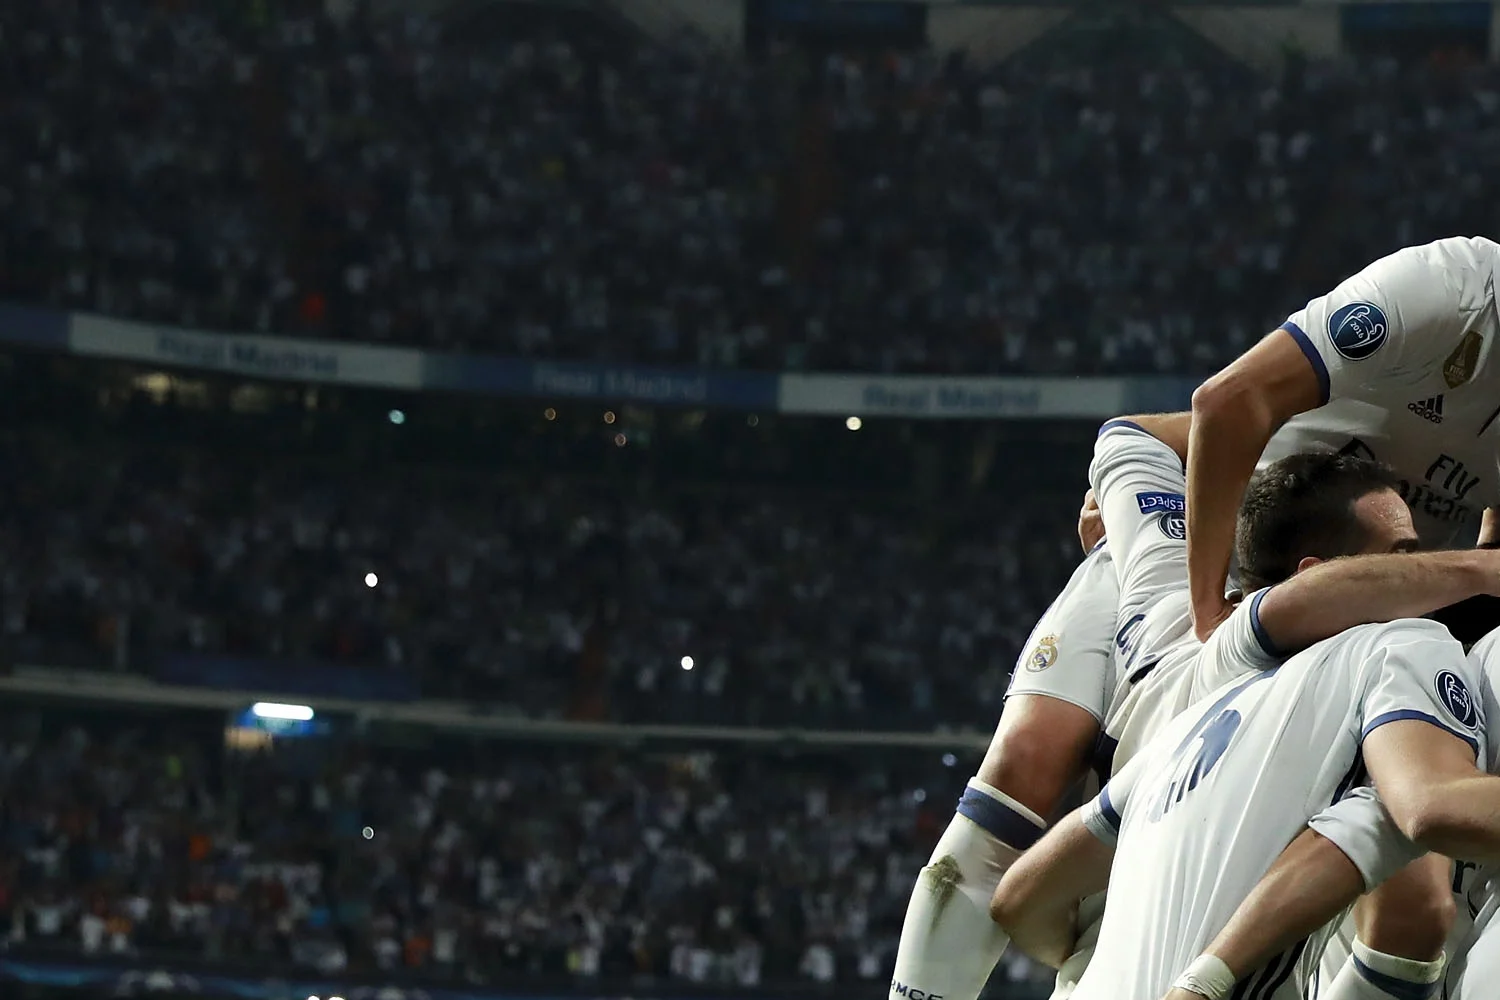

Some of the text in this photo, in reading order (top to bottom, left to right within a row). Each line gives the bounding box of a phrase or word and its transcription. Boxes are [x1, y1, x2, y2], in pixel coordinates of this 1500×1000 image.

[1350, 321, 1365, 339] 2016
[1425, 454, 1480, 500] Fly
[1140, 496, 1185, 510] ESPECT
